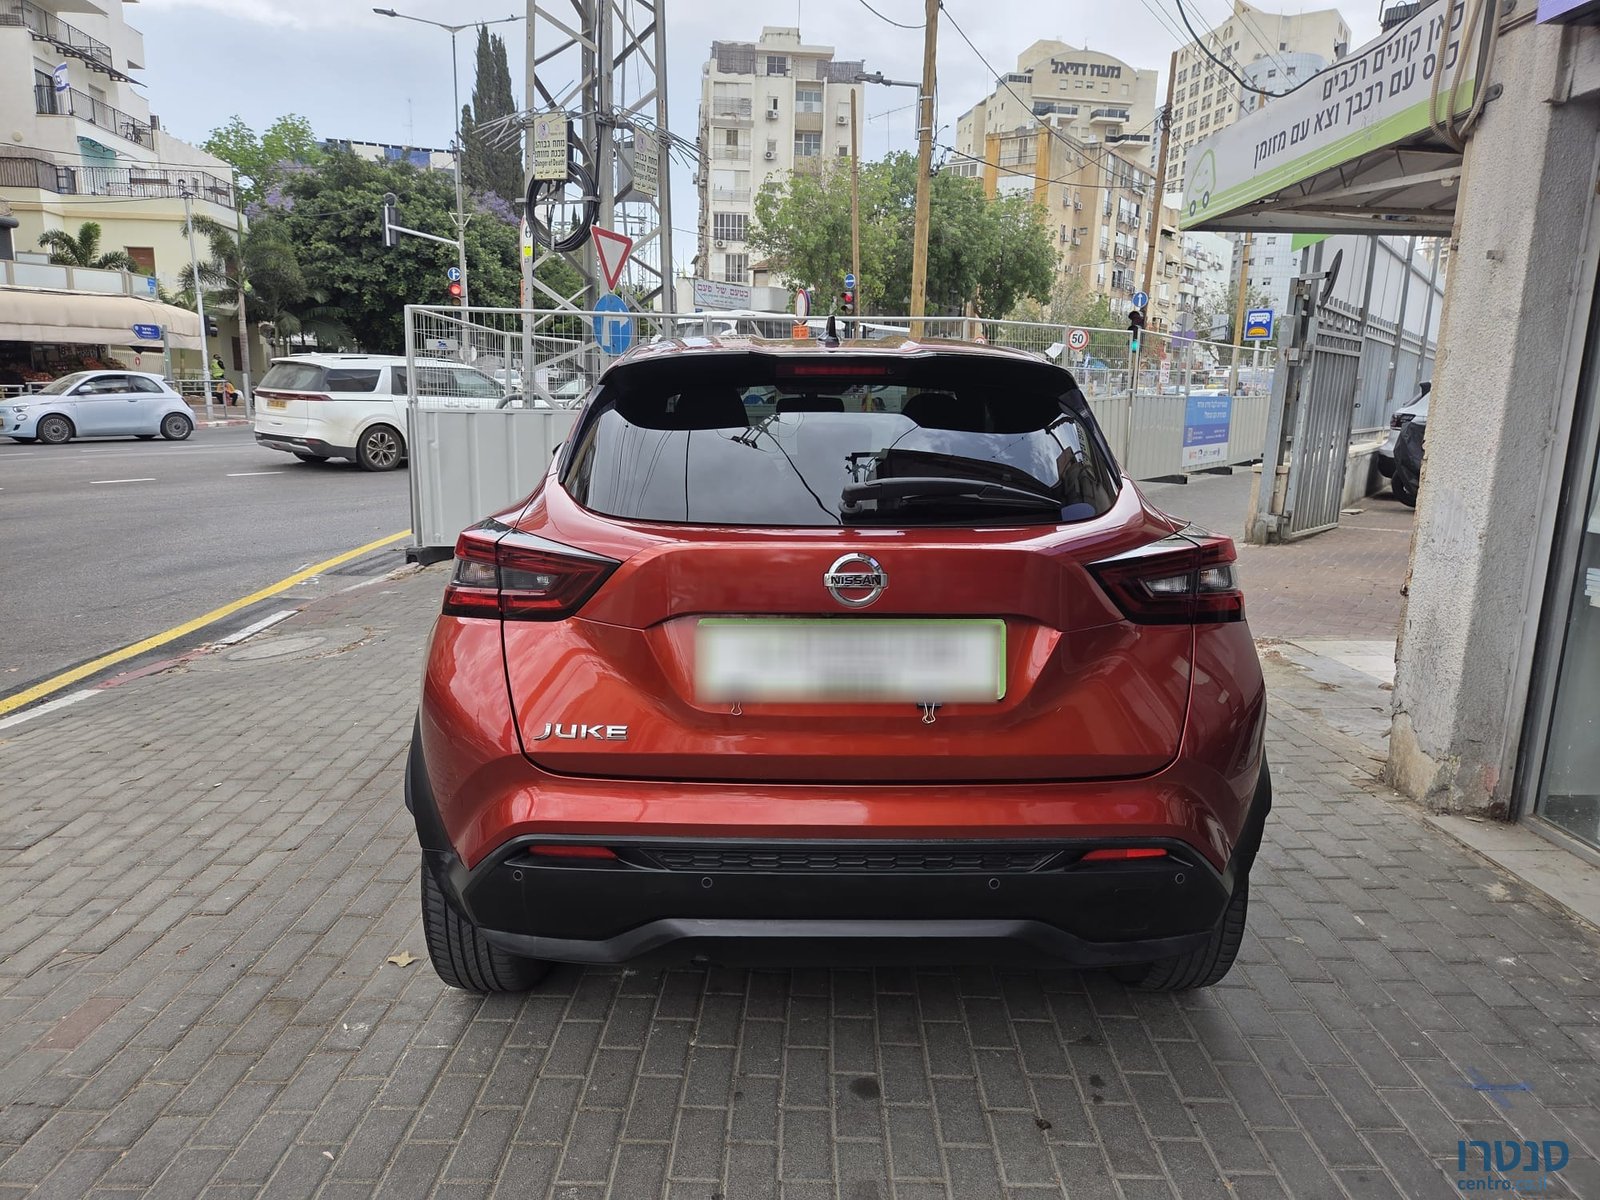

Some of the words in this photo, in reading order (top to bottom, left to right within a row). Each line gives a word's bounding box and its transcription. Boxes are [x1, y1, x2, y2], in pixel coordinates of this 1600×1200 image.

[1373, 27, 1422, 74] קונים
[1423, 40, 1460, 80] כס
[1322, 58, 1367, 101] רכבים
[1388, 63, 1416, 97] עם
[1313, 103, 1340, 135] וצא
[1345, 81, 1383, 125] רכבך
[1290, 118, 1311, 146] עם
[1254, 131, 1287, 169] מזומן
[716, 284, 727, 294] של
[1072, 333, 1084, 343] 50
[831, 575, 882, 586] NISSAN
[533, 722, 629, 741] JUKE
